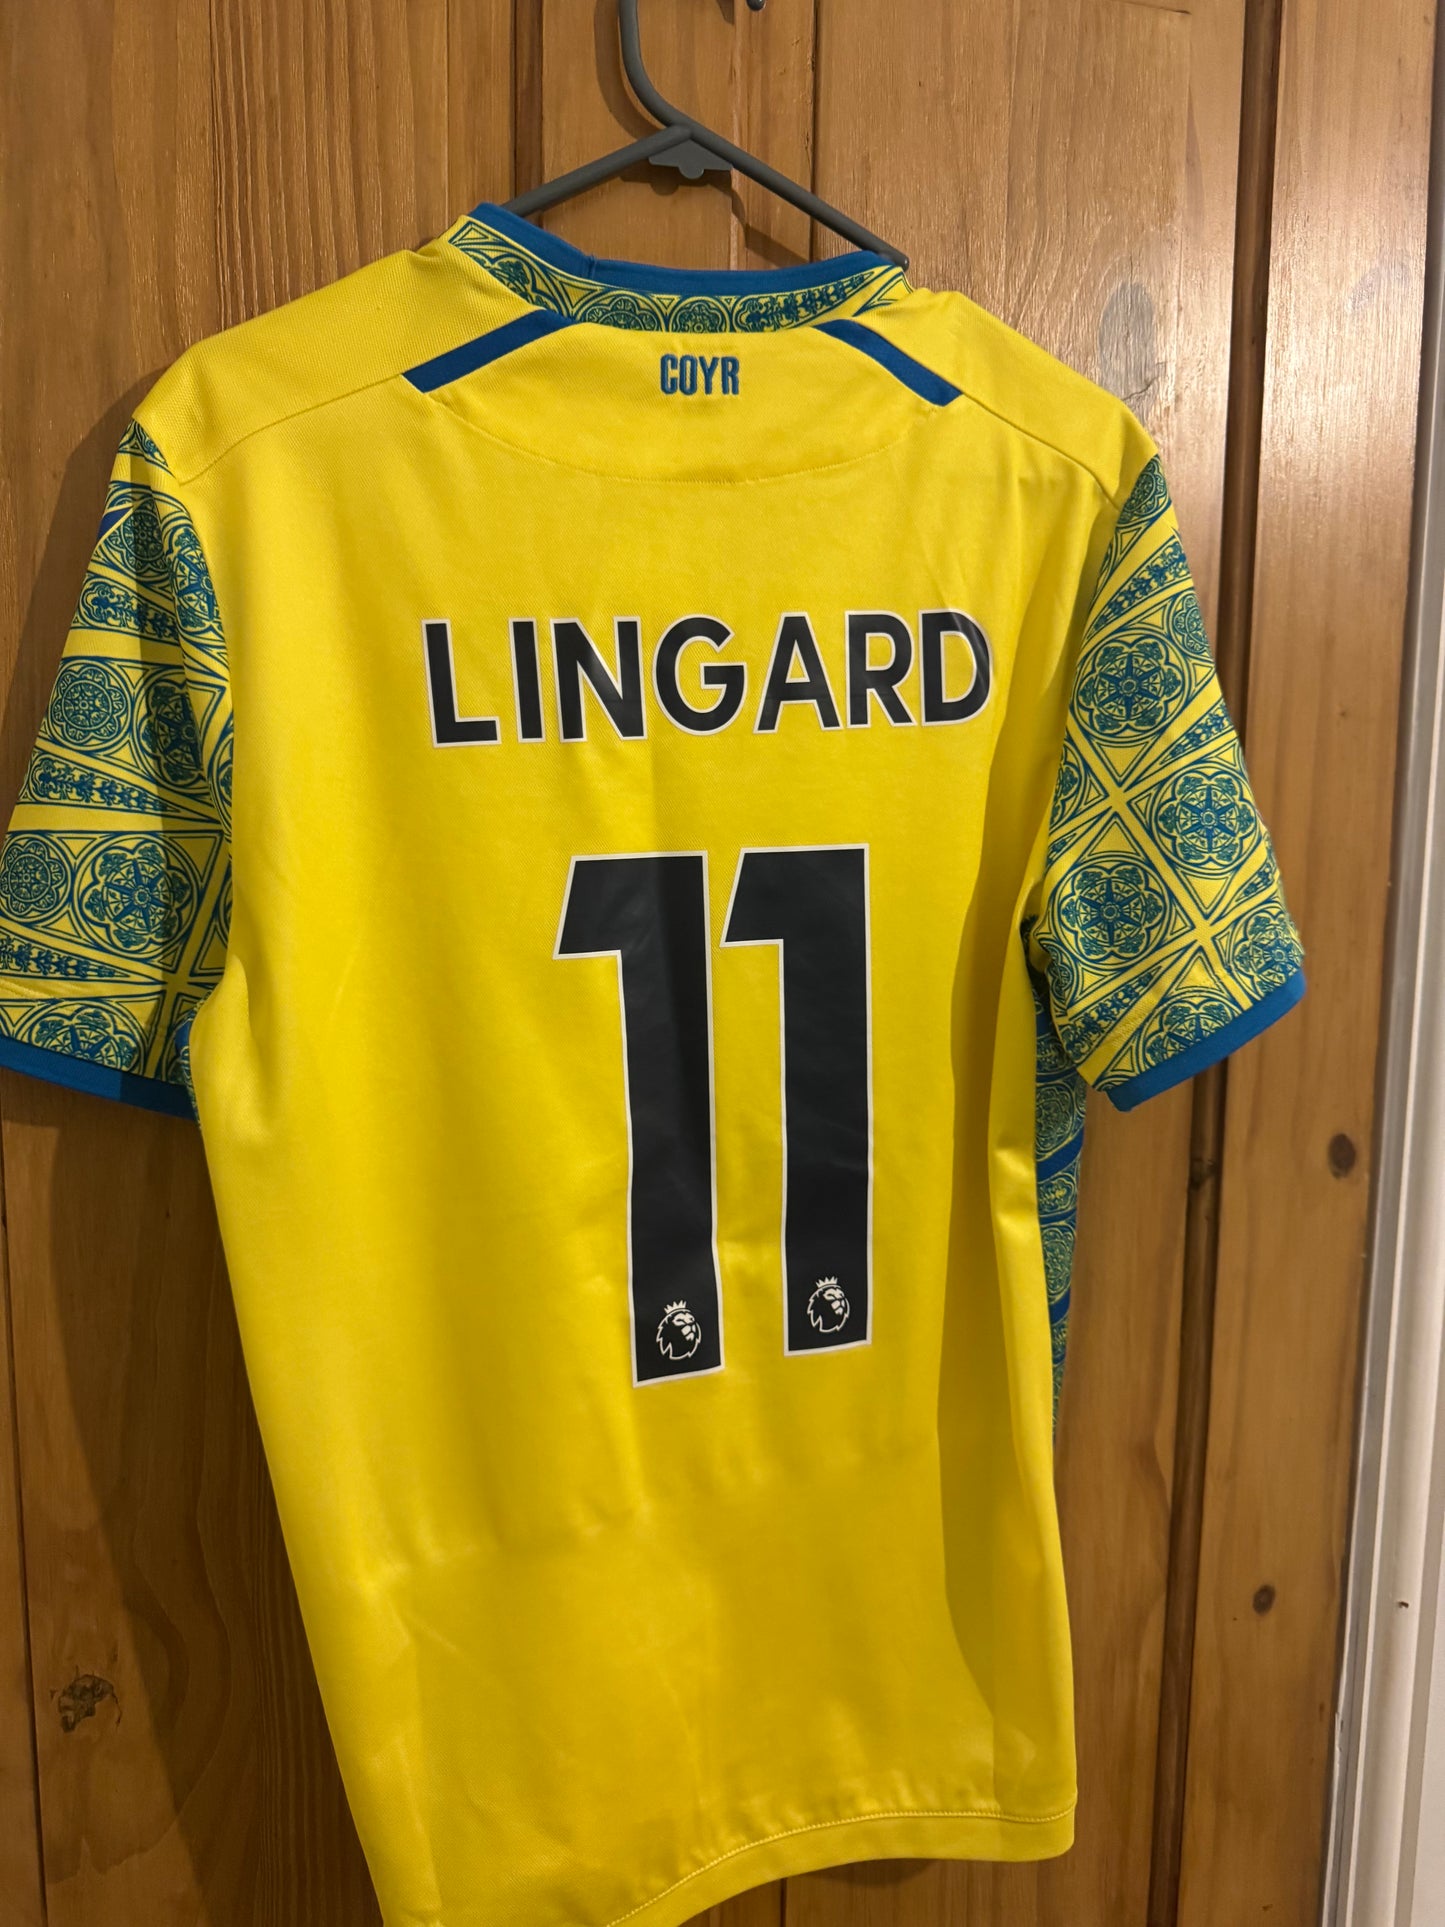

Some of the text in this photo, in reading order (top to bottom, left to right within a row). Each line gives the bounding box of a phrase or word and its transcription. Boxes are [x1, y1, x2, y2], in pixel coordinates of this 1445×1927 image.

[660, 353, 740, 396] COYR
[422, 609, 993, 747] LINGARD
[553, 843, 872, 1387] 11
